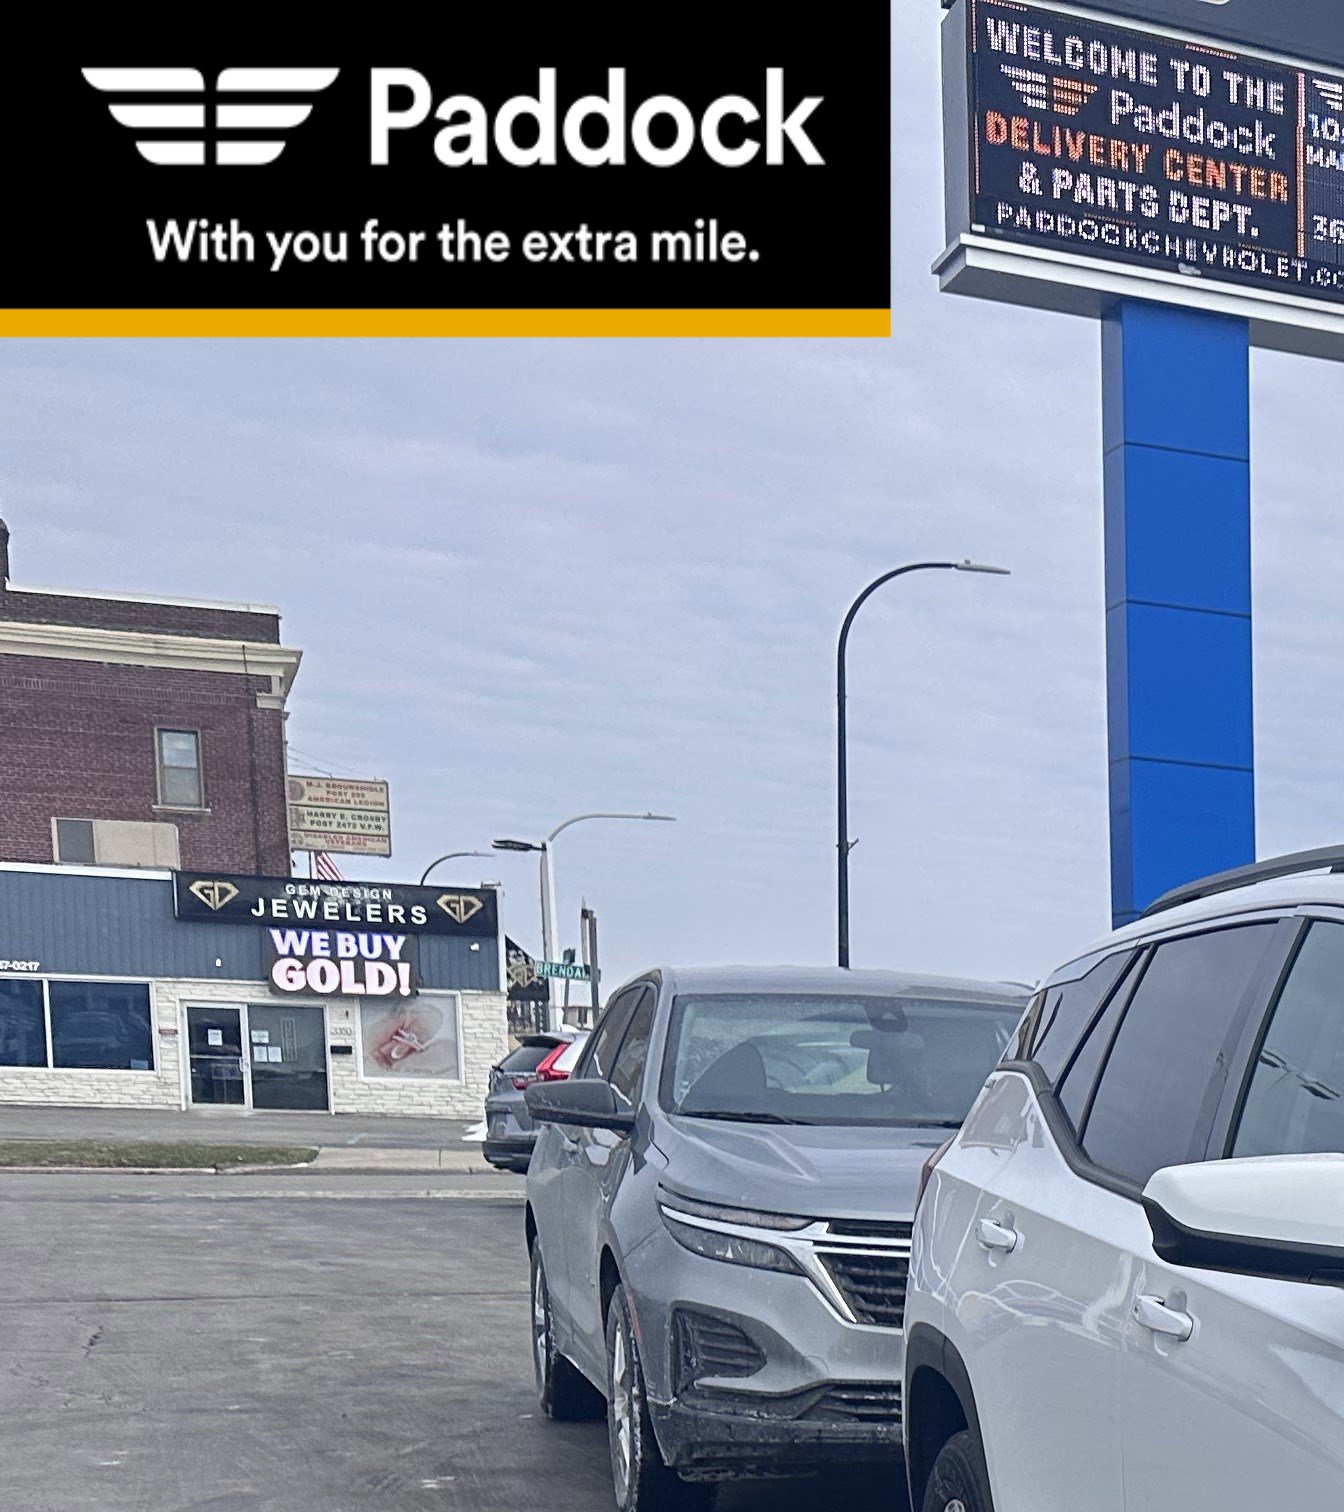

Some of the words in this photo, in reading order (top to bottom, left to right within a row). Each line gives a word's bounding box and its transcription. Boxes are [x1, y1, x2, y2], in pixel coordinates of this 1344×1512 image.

[986, 17, 1159, 88] WELCOME
[1170, 59, 1211, 98] TO
[1222, 70, 1285, 115] THE
[1111, 89, 1276, 159] Paddock
[985, 110, 1151, 175] DELIVERY
[1163, 149, 1289, 203] CENTER
[1018, 161, 1044, 196] &
[1052, 168, 1159, 219] PARTS
[1169, 191, 1260, 238] DEPT.
[306, 810, 336, 819] HARRY
[250, 898, 428, 925] JEWELERS
[285, 884, 321, 896] GEM
[329, 886, 392, 900] DESIGN
[269, 928, 332, 958] WE
[337, 932, 406, 961] BUY
[271, 957, 412, 998] GOLD!
